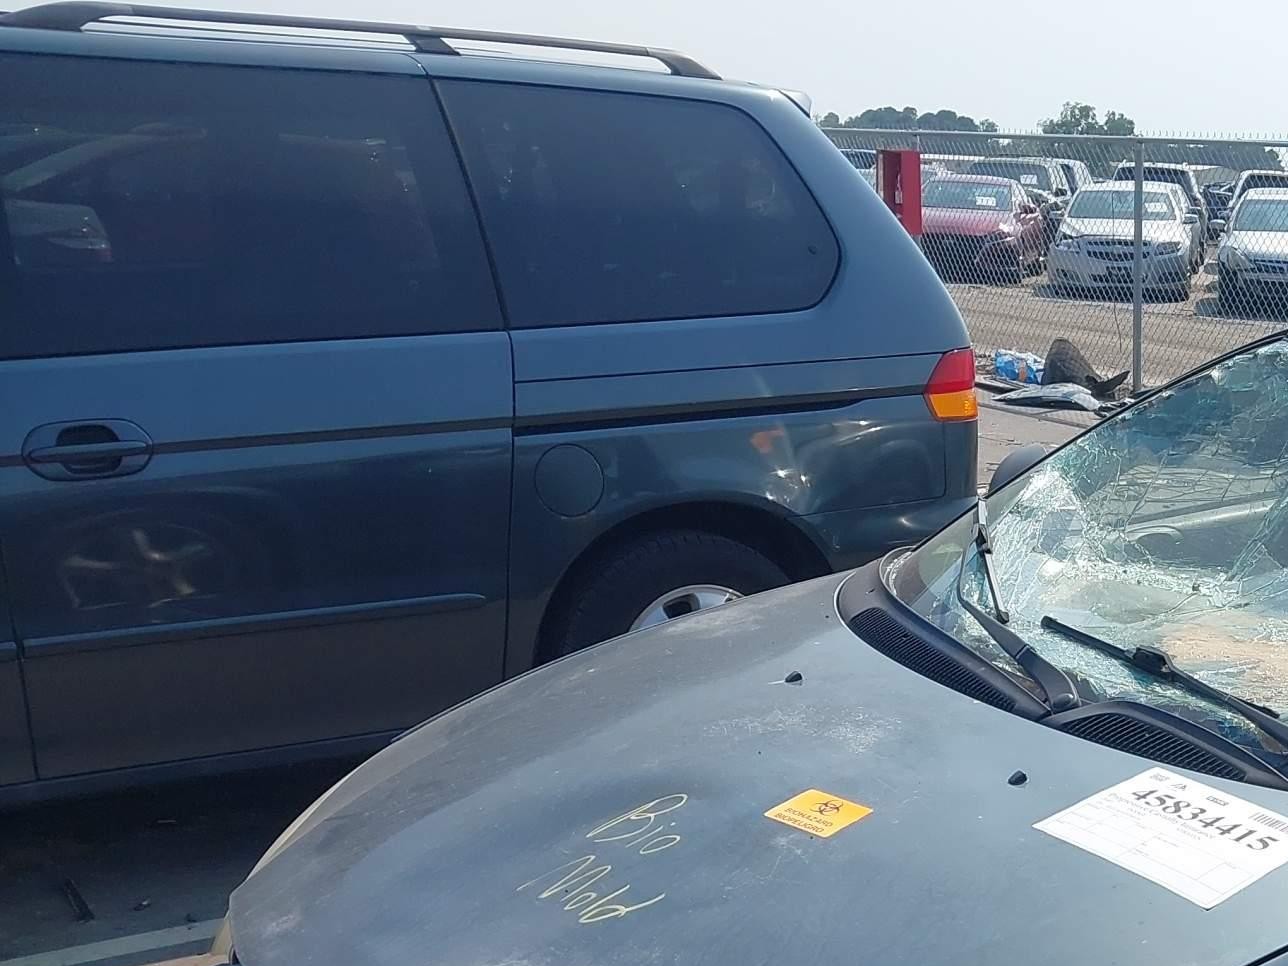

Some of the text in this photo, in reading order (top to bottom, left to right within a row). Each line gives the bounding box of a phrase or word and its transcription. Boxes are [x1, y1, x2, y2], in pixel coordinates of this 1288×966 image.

[586, 793, 688, 854] Bio
[784, 807, 834, 828] BIOHAZARD
[1131, 789, 1280, 851] 45834415
